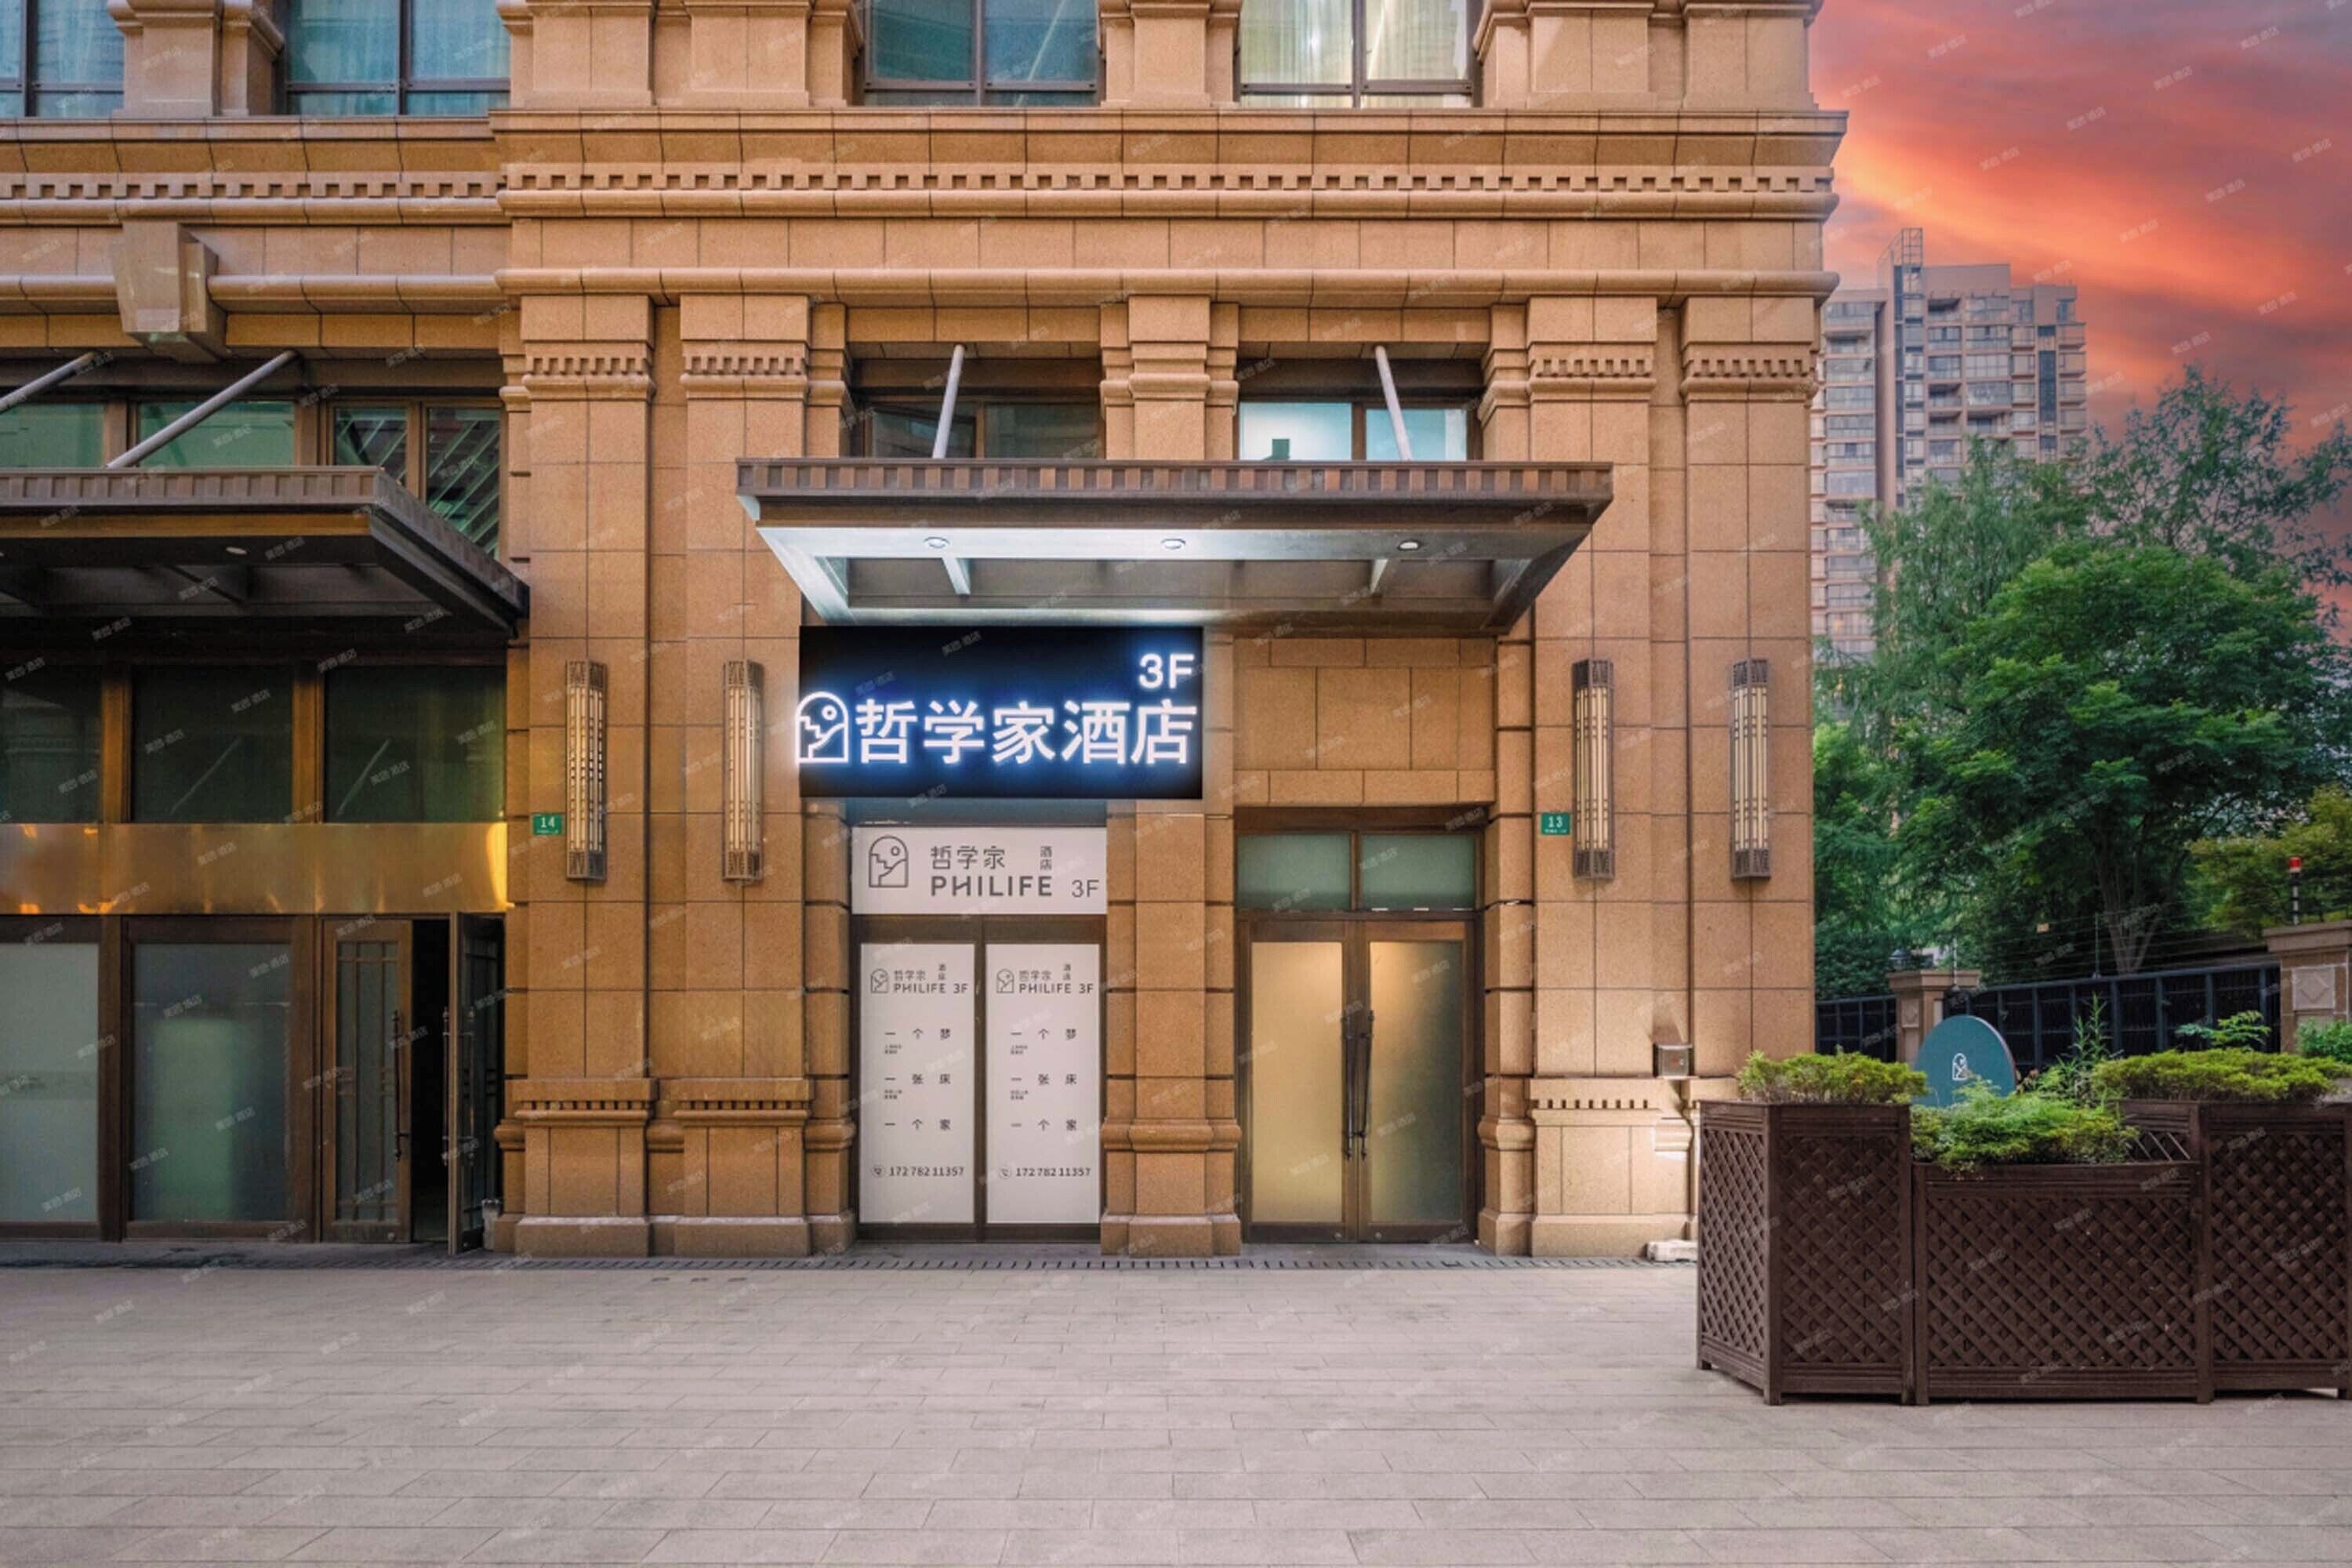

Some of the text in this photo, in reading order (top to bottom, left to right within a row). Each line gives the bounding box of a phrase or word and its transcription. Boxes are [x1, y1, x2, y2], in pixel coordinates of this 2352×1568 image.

[1138, 654, 1195, 688] 3F
[855, 699, 1197, 764] 哲学家酒店
[541, 816, 555, 828] 14
[1548, 815, 1563, 828] 13
[931, 845, 1005, 869] 哲学家
[931, 876, 1099, 898] PHILIFE 3F
[894, 983, 968, 993] PHILIFE 3F
[1019, 983, 1094, 993] PHILIFE 3F
